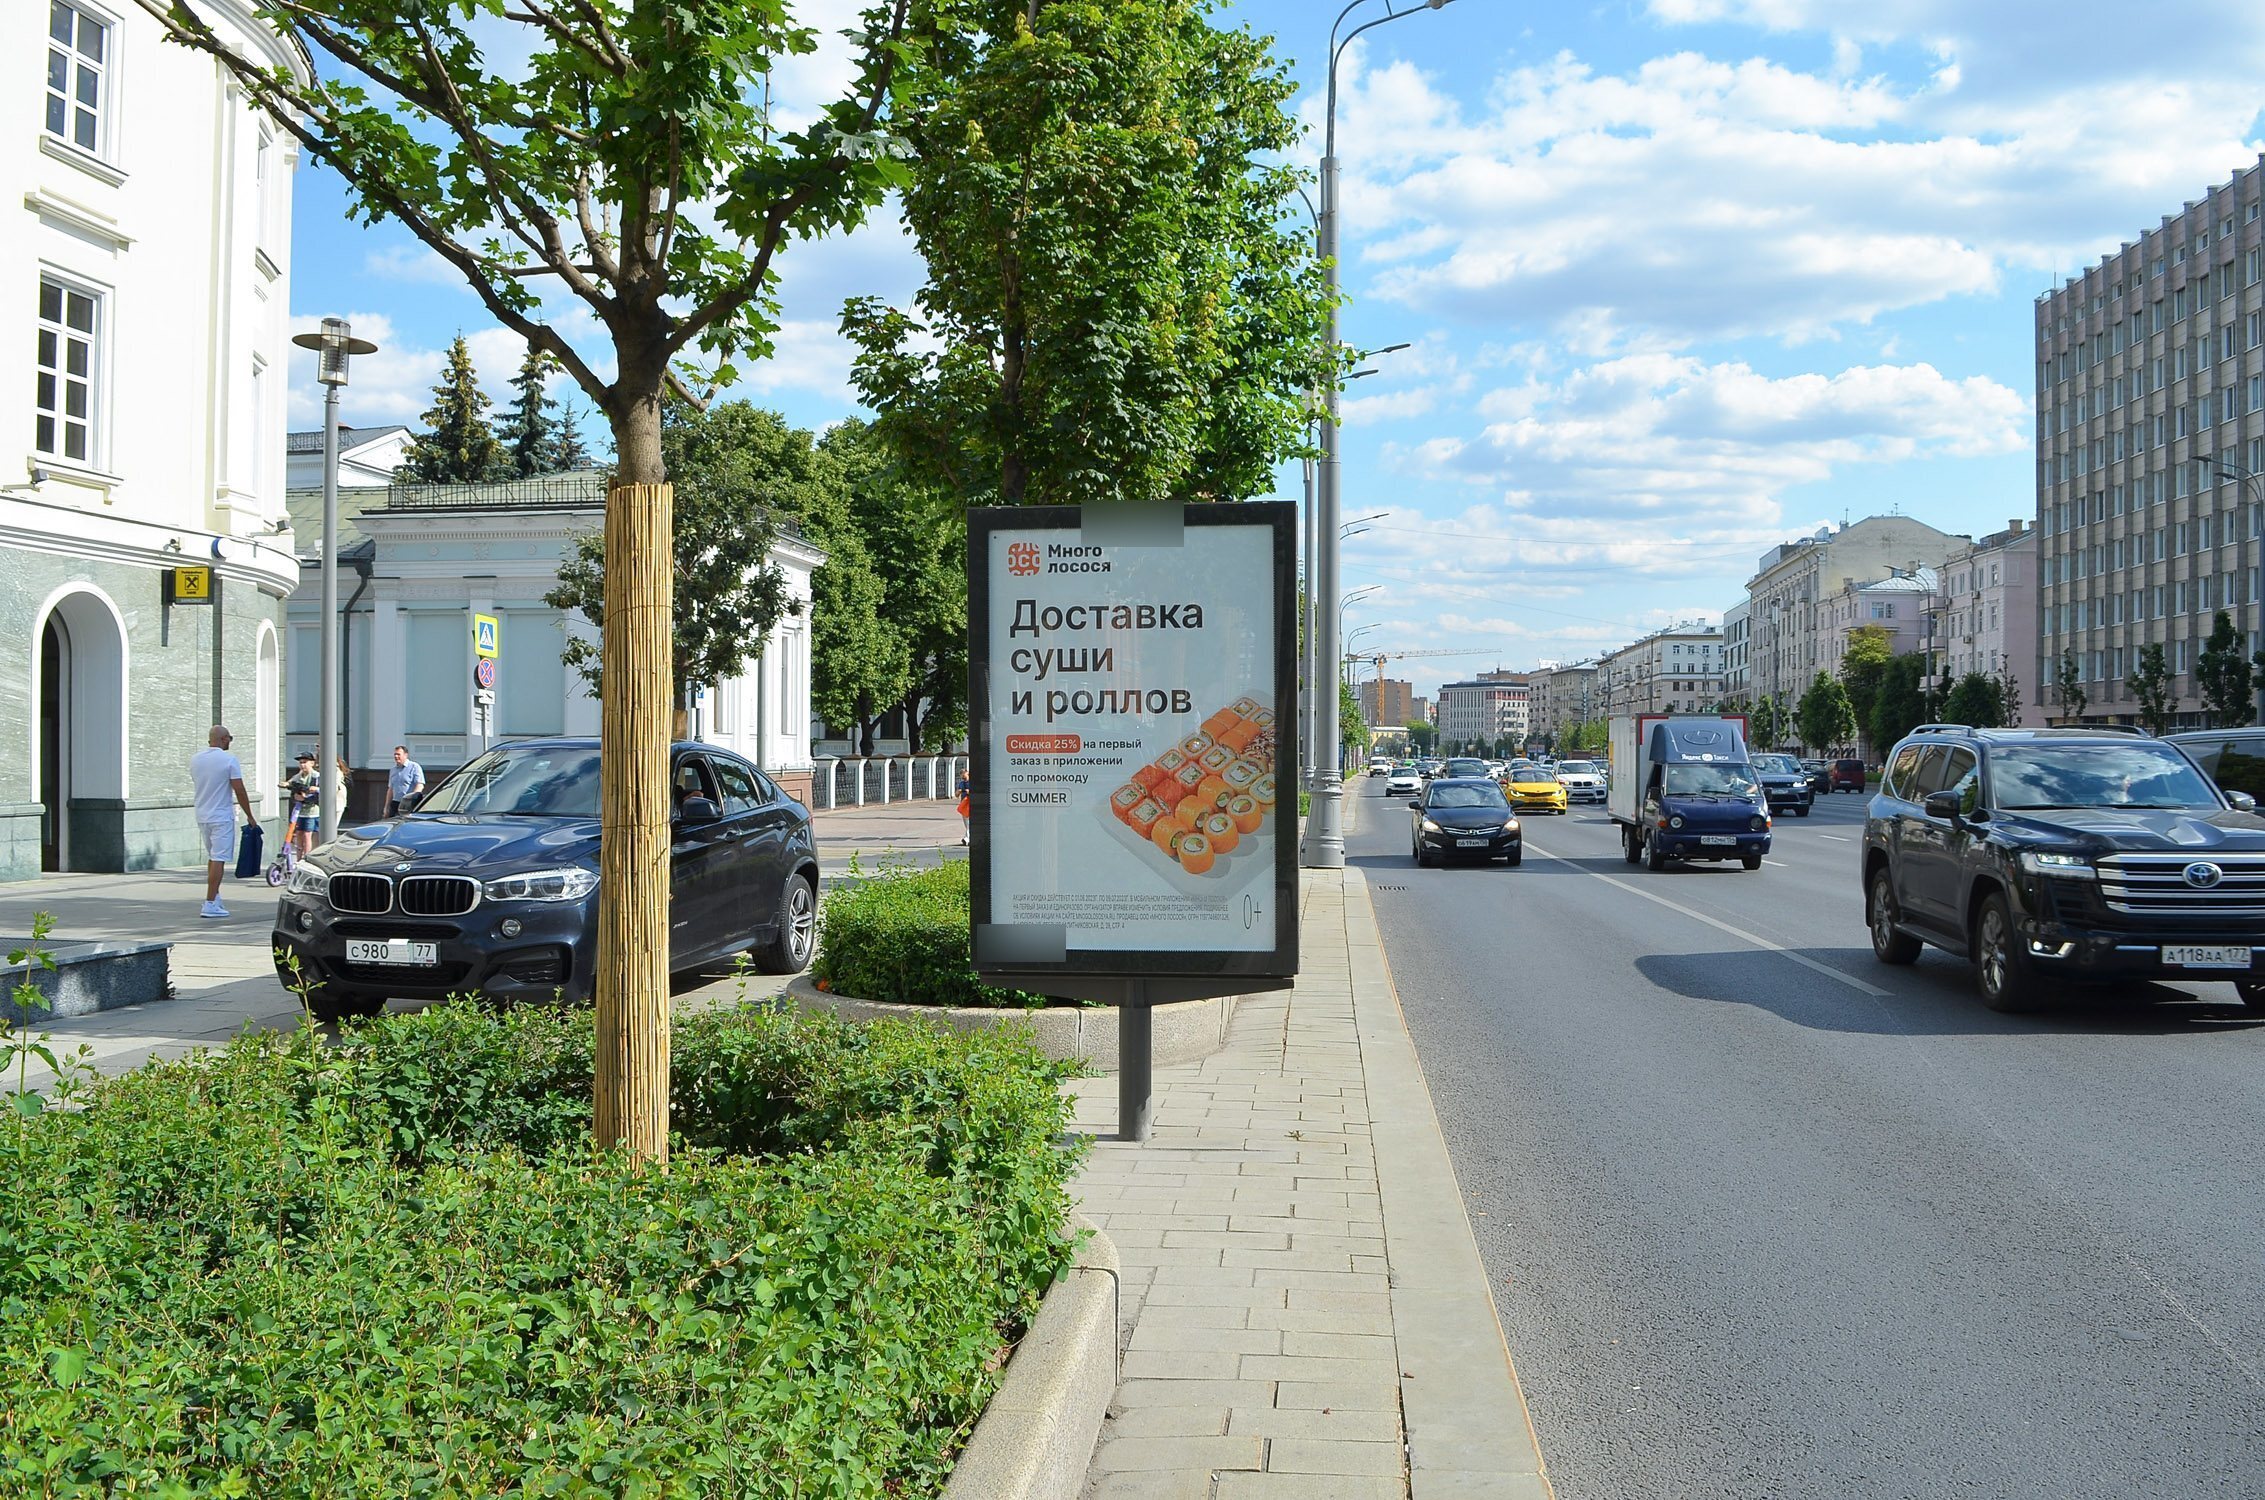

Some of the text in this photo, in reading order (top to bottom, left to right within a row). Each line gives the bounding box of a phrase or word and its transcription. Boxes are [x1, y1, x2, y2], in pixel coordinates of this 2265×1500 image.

[1047, 544, 1103, 558] Много
[1047, 561, 1112, 573] лосося
[1009, 599, 1204, 638] Доставка
[1010, 647, 1113, 680] суши
[1011, 689, 1193, 723] и роллов
[1010, 738, 1142, 750] Скидка 25% на первый
[1010, 758, 1041, 766] заказ
[1053, 757, 1123, 767] приложении
[1010, 774, 1089, 784] по промокоду
[1011, 792, 1067, 804] SUMMER
[1243, 894, 1262, 930] 0+
[416, 944, 431, 957] 77
